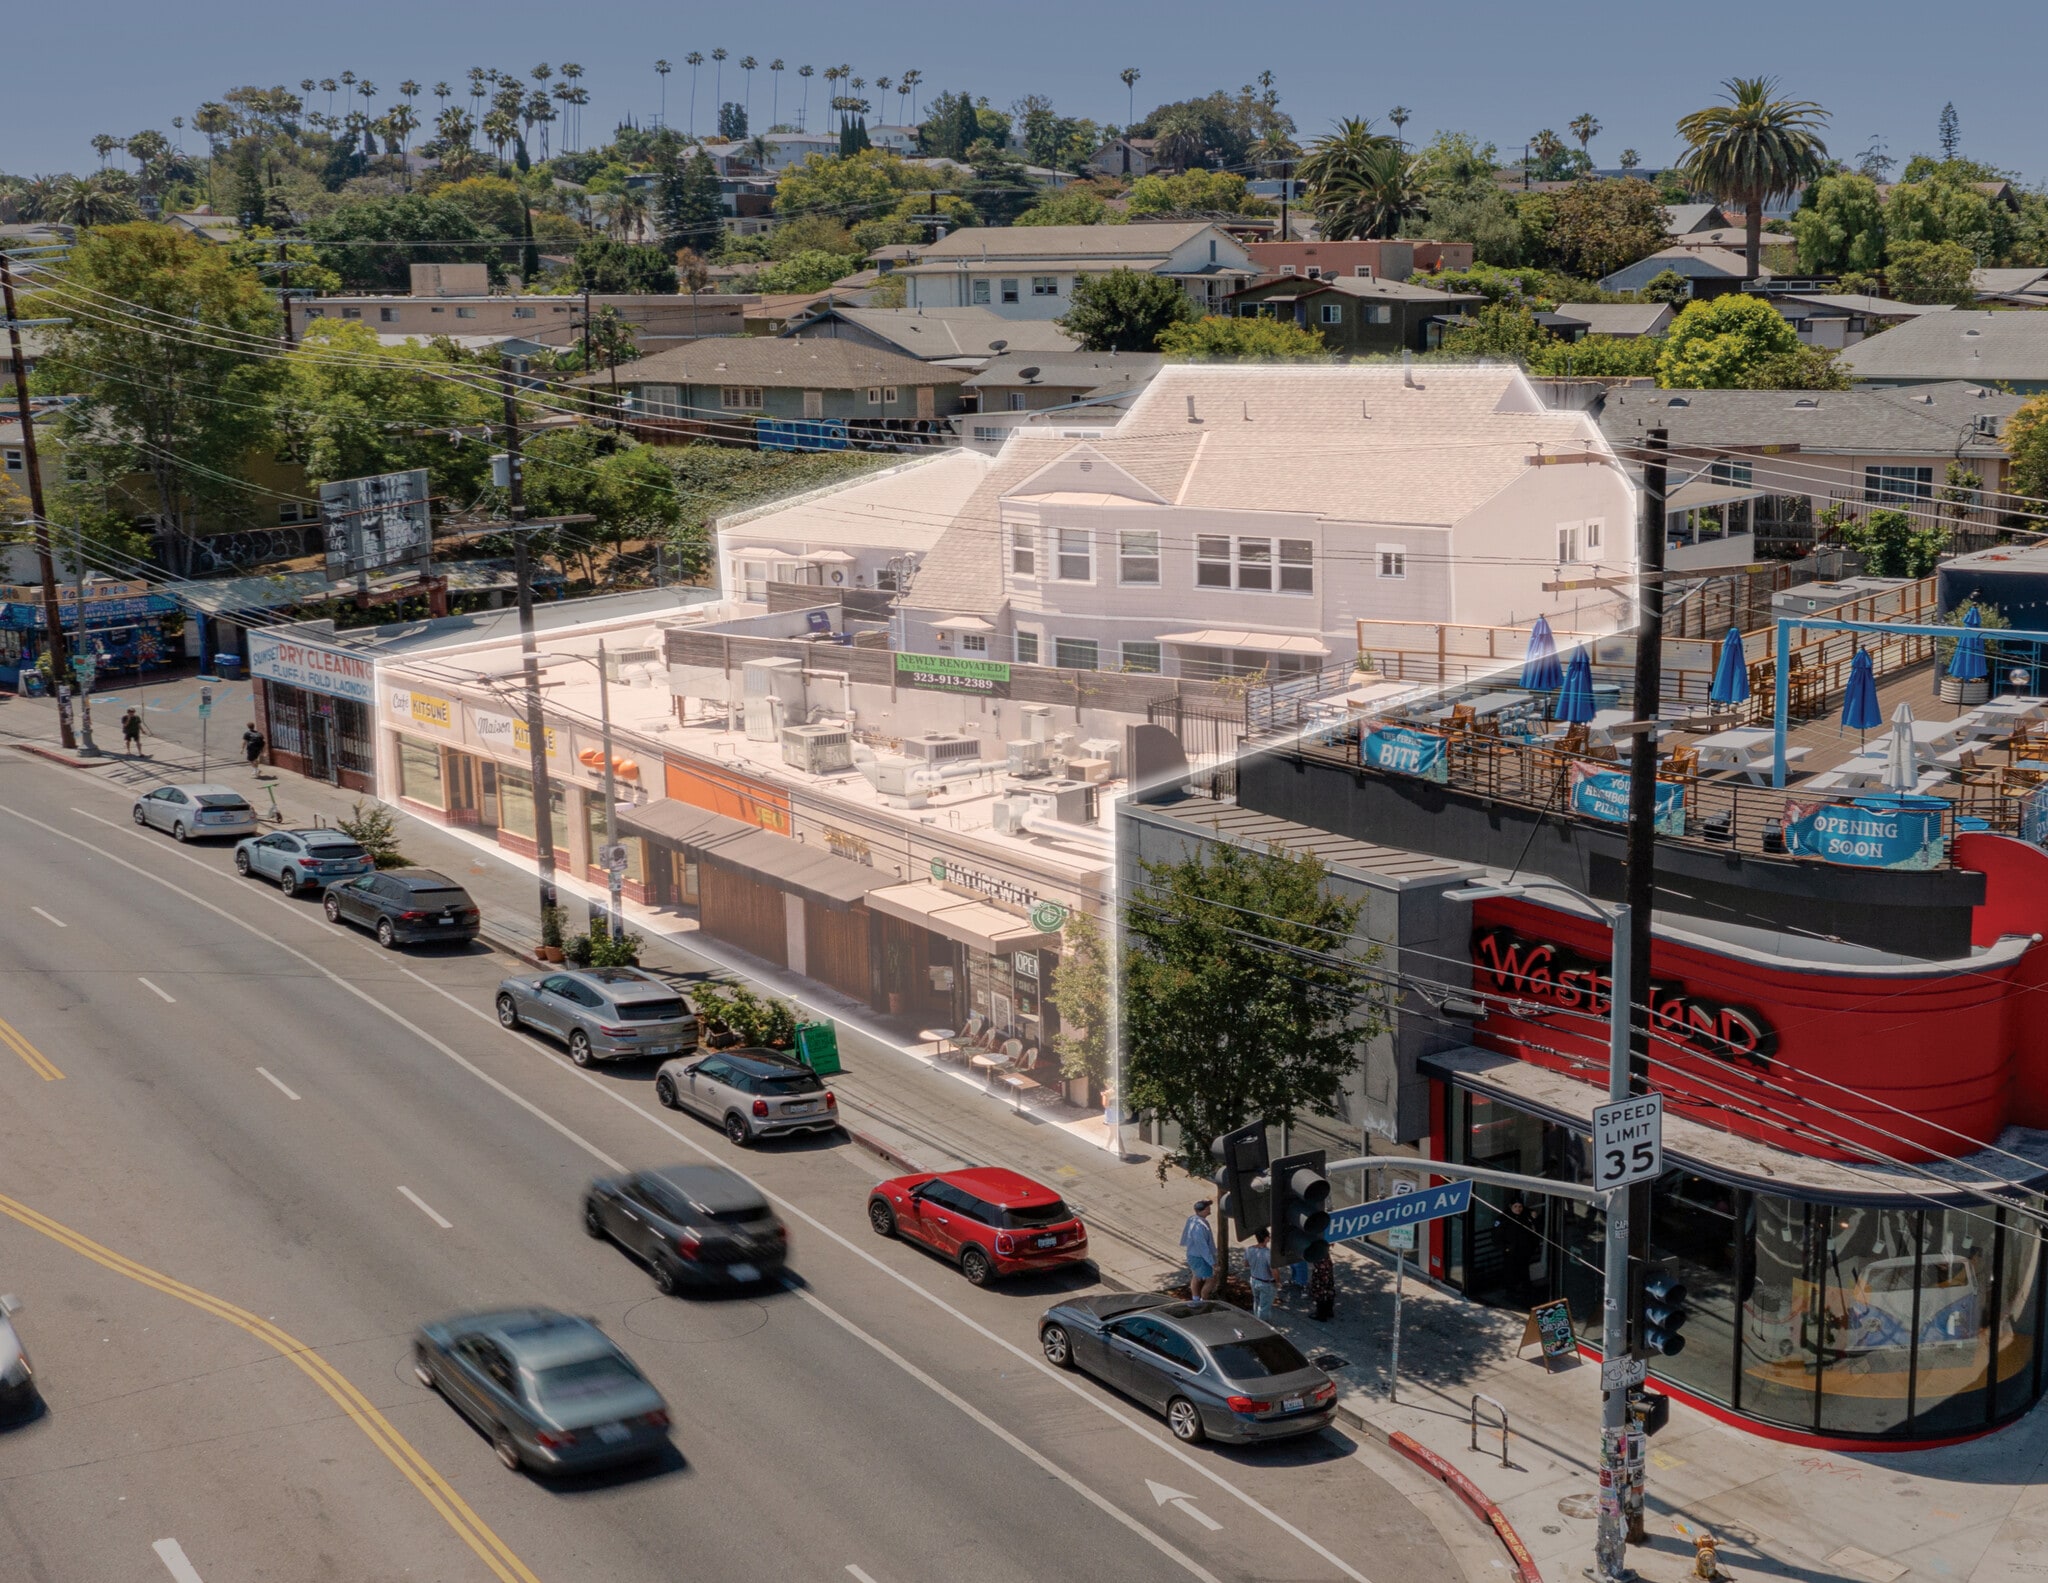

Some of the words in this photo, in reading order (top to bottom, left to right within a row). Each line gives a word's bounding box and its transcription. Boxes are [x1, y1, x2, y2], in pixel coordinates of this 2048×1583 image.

[279, 643, 304, 665] DRY
[307, 650, 374, 680] CLEANING
[901, 654, 938, 666] NEWLY
[938, 658, 1007, 674] RENOVATED!
[272, 664, 299, 679] FLUFF
[308, 672, 331, 687] FOLD
[913, 672, 993, 689] 323-913-2389
[413, 700, 448, 722] KITSUNÉ
[478, 717, 511, 735] Maison
[515, 727, 555, 750] KITÉ
[1380, 743, 1421, 774] BITE
[1814, 815, 1898, 839] OPENING
[1828, 838, 1883, 859] SOON
[1600, 1103, 1656, 1127] SPEED
[1606, 1123, 1650, 1145] LIMIT
[1603, 1141, 1654, 1180] 35
[1329, 1201, 1427, 1236] Hyperion
[1434, 1192, 1461, 1210] Av
